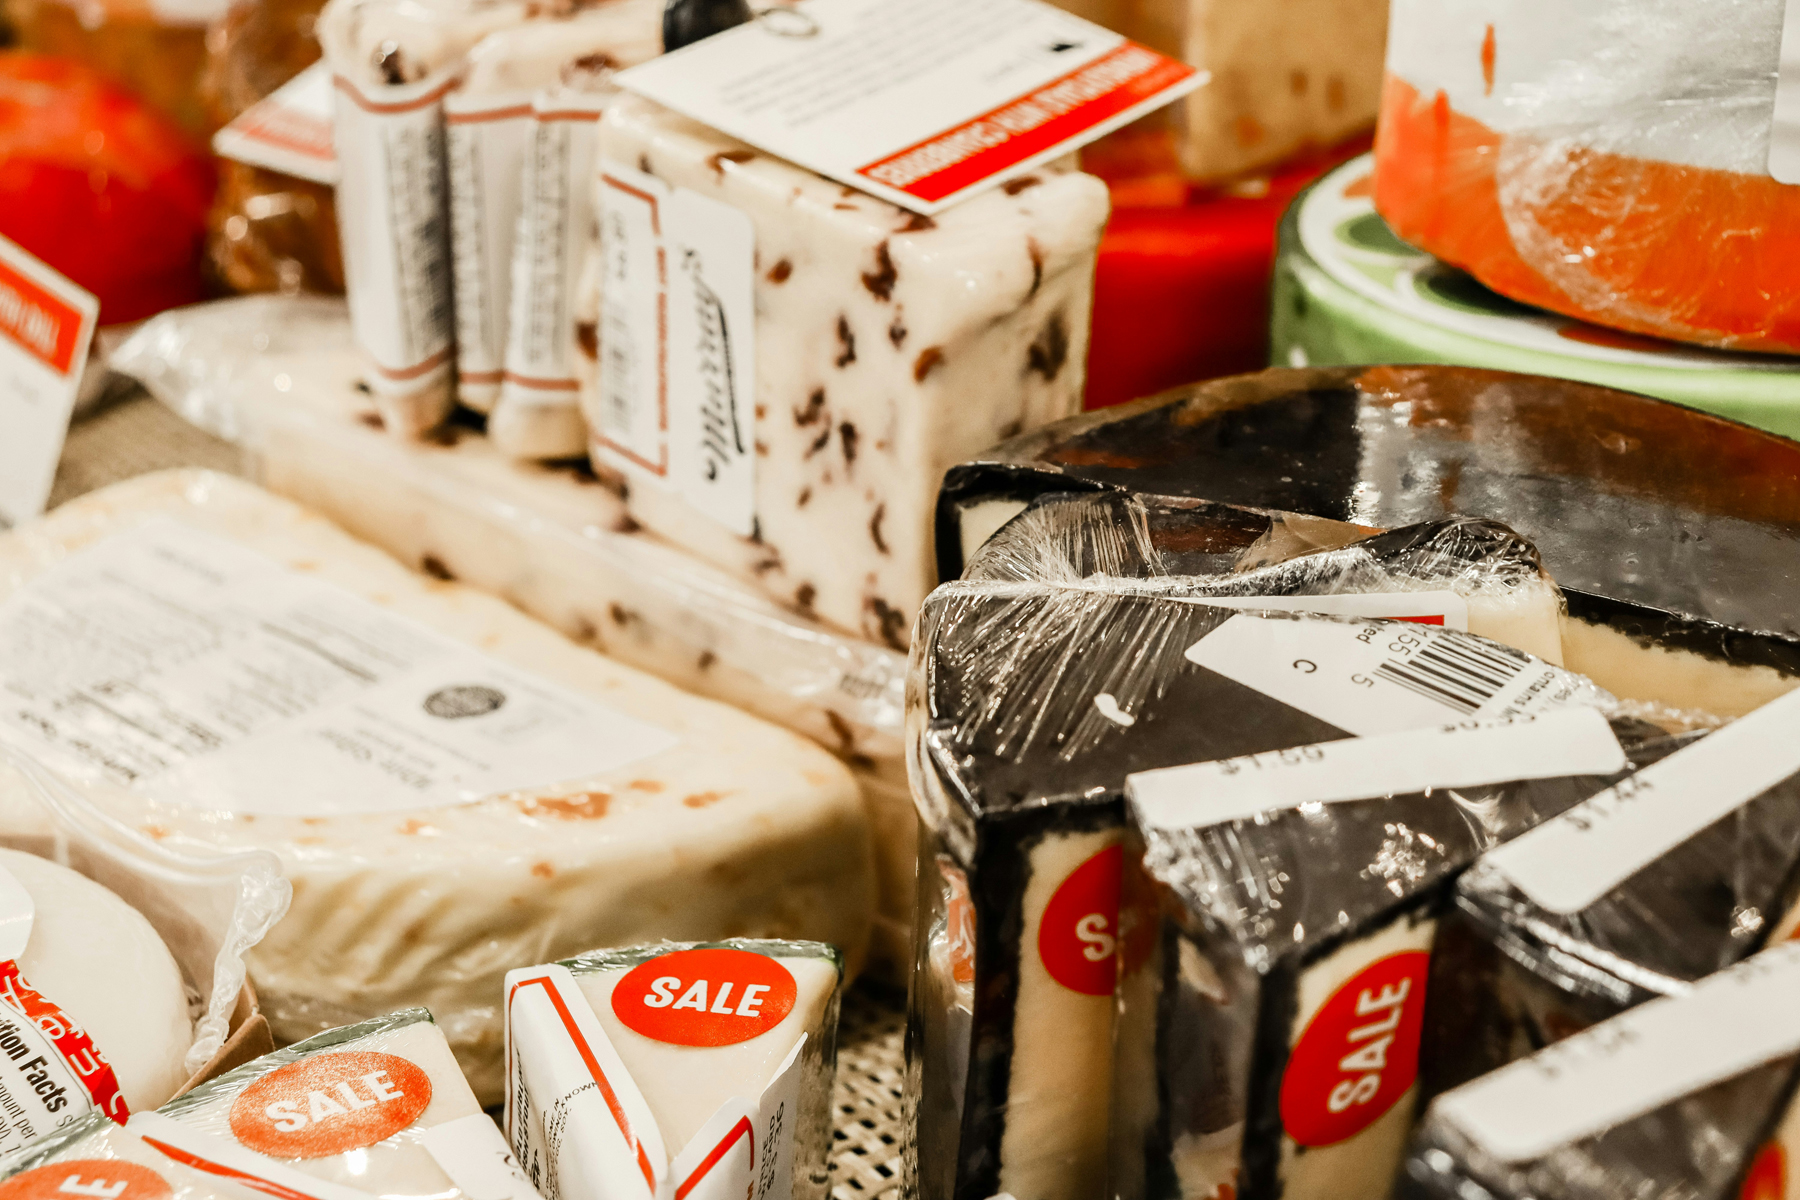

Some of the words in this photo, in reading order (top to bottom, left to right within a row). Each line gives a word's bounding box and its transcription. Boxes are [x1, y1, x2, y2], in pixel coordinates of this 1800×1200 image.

[1350, 672, 1375, 689] 5
[1513, 671, 1556, 706] ontains
[643, 976, 772, 1018] SALE
[1327, 976, 1412, 1115] SALE
[0, 1075, 26, 1119] mount
[18, 1054, 69, 1113] Facts
[264, 1069, 405, 1133] SALE
[560, 1080, 599, 1109] KNOWN
[12, 1118, 38, 1140] per
